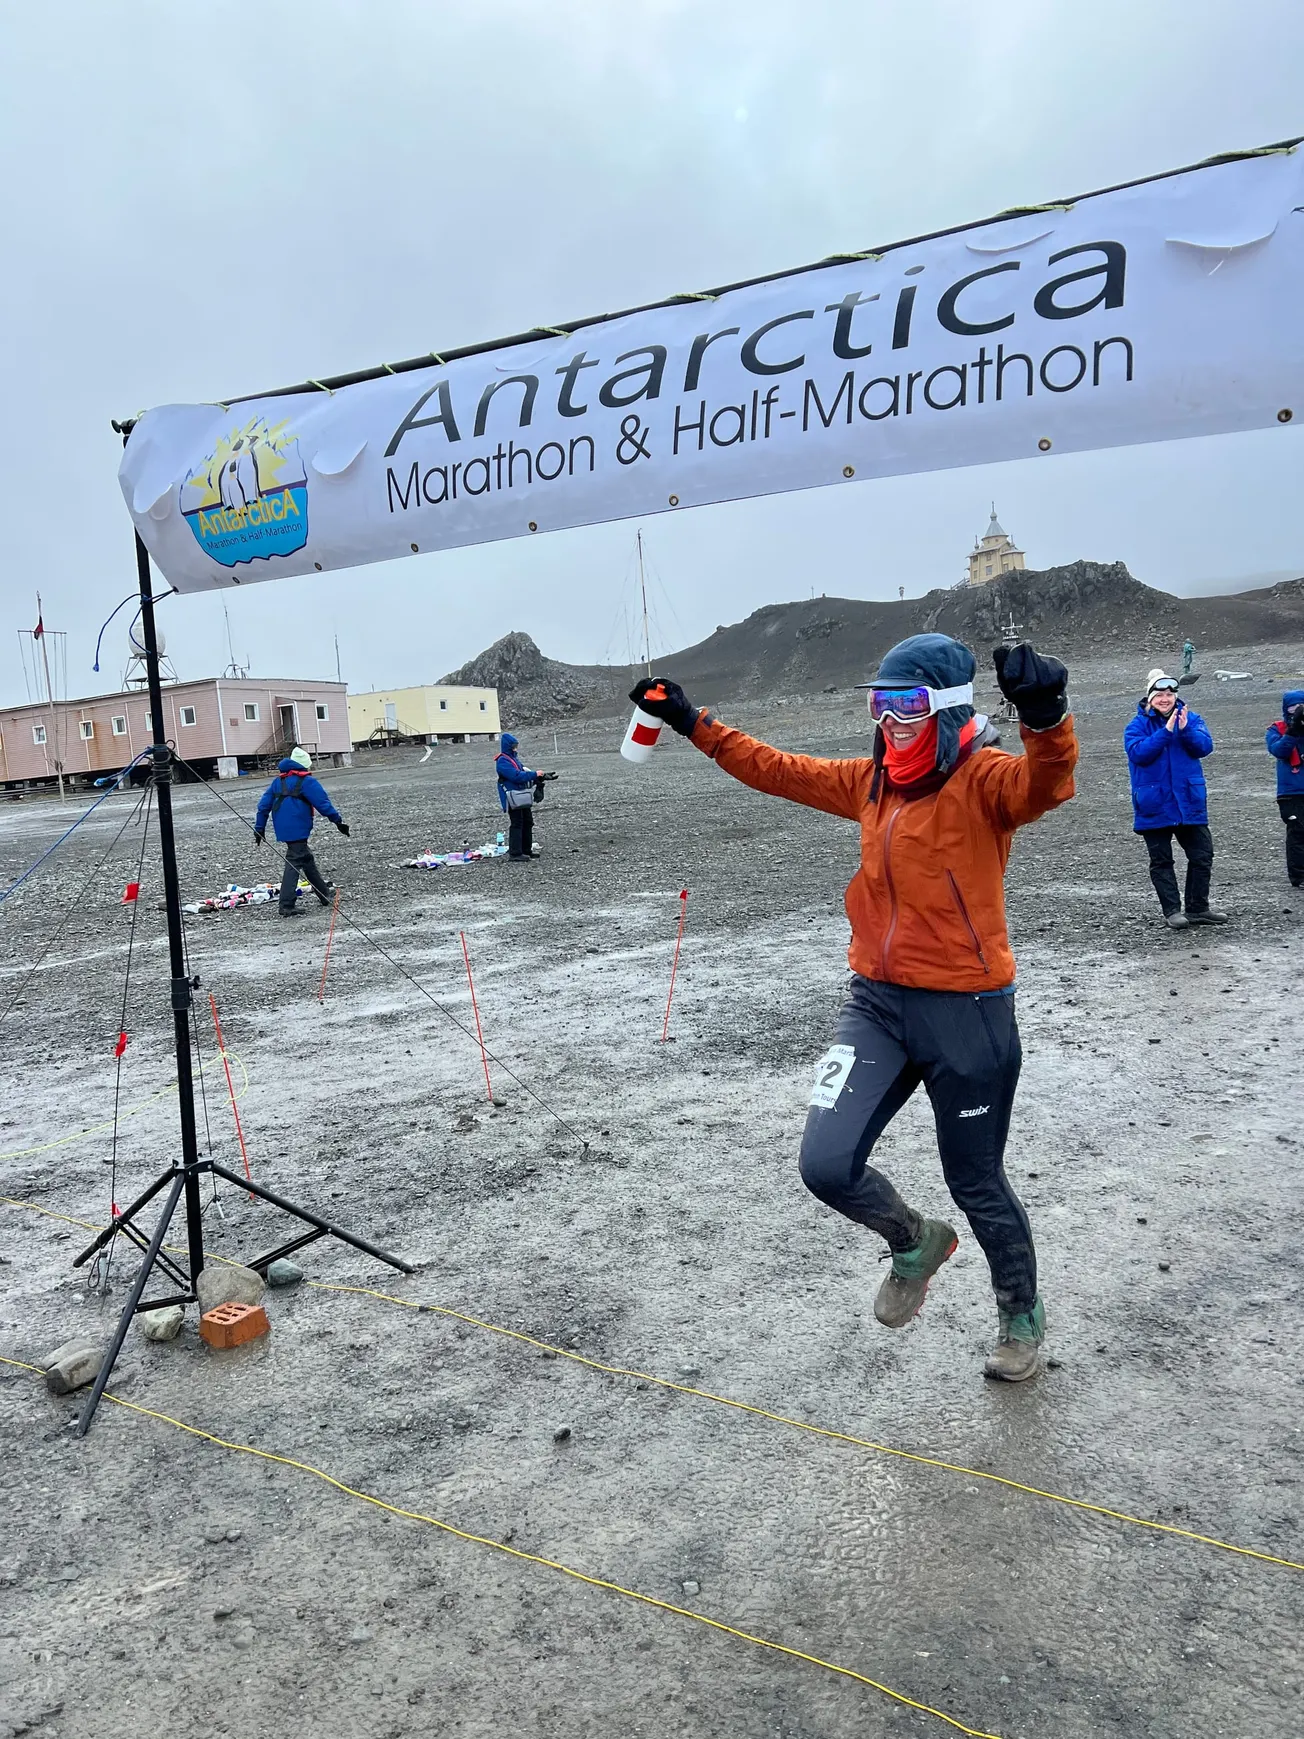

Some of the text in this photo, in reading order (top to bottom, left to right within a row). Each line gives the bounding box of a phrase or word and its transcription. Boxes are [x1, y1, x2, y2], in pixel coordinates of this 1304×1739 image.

[384, 239, 1127, 458] Antarctica
[386, 336, 1133, 513] Marathon & Half-Marathon
[197, 488, 300, 538] AntarcticA
[206, 522, 303, 550] Marathon & Half-Marathon
[820, 1060, 843, 1089] 2
